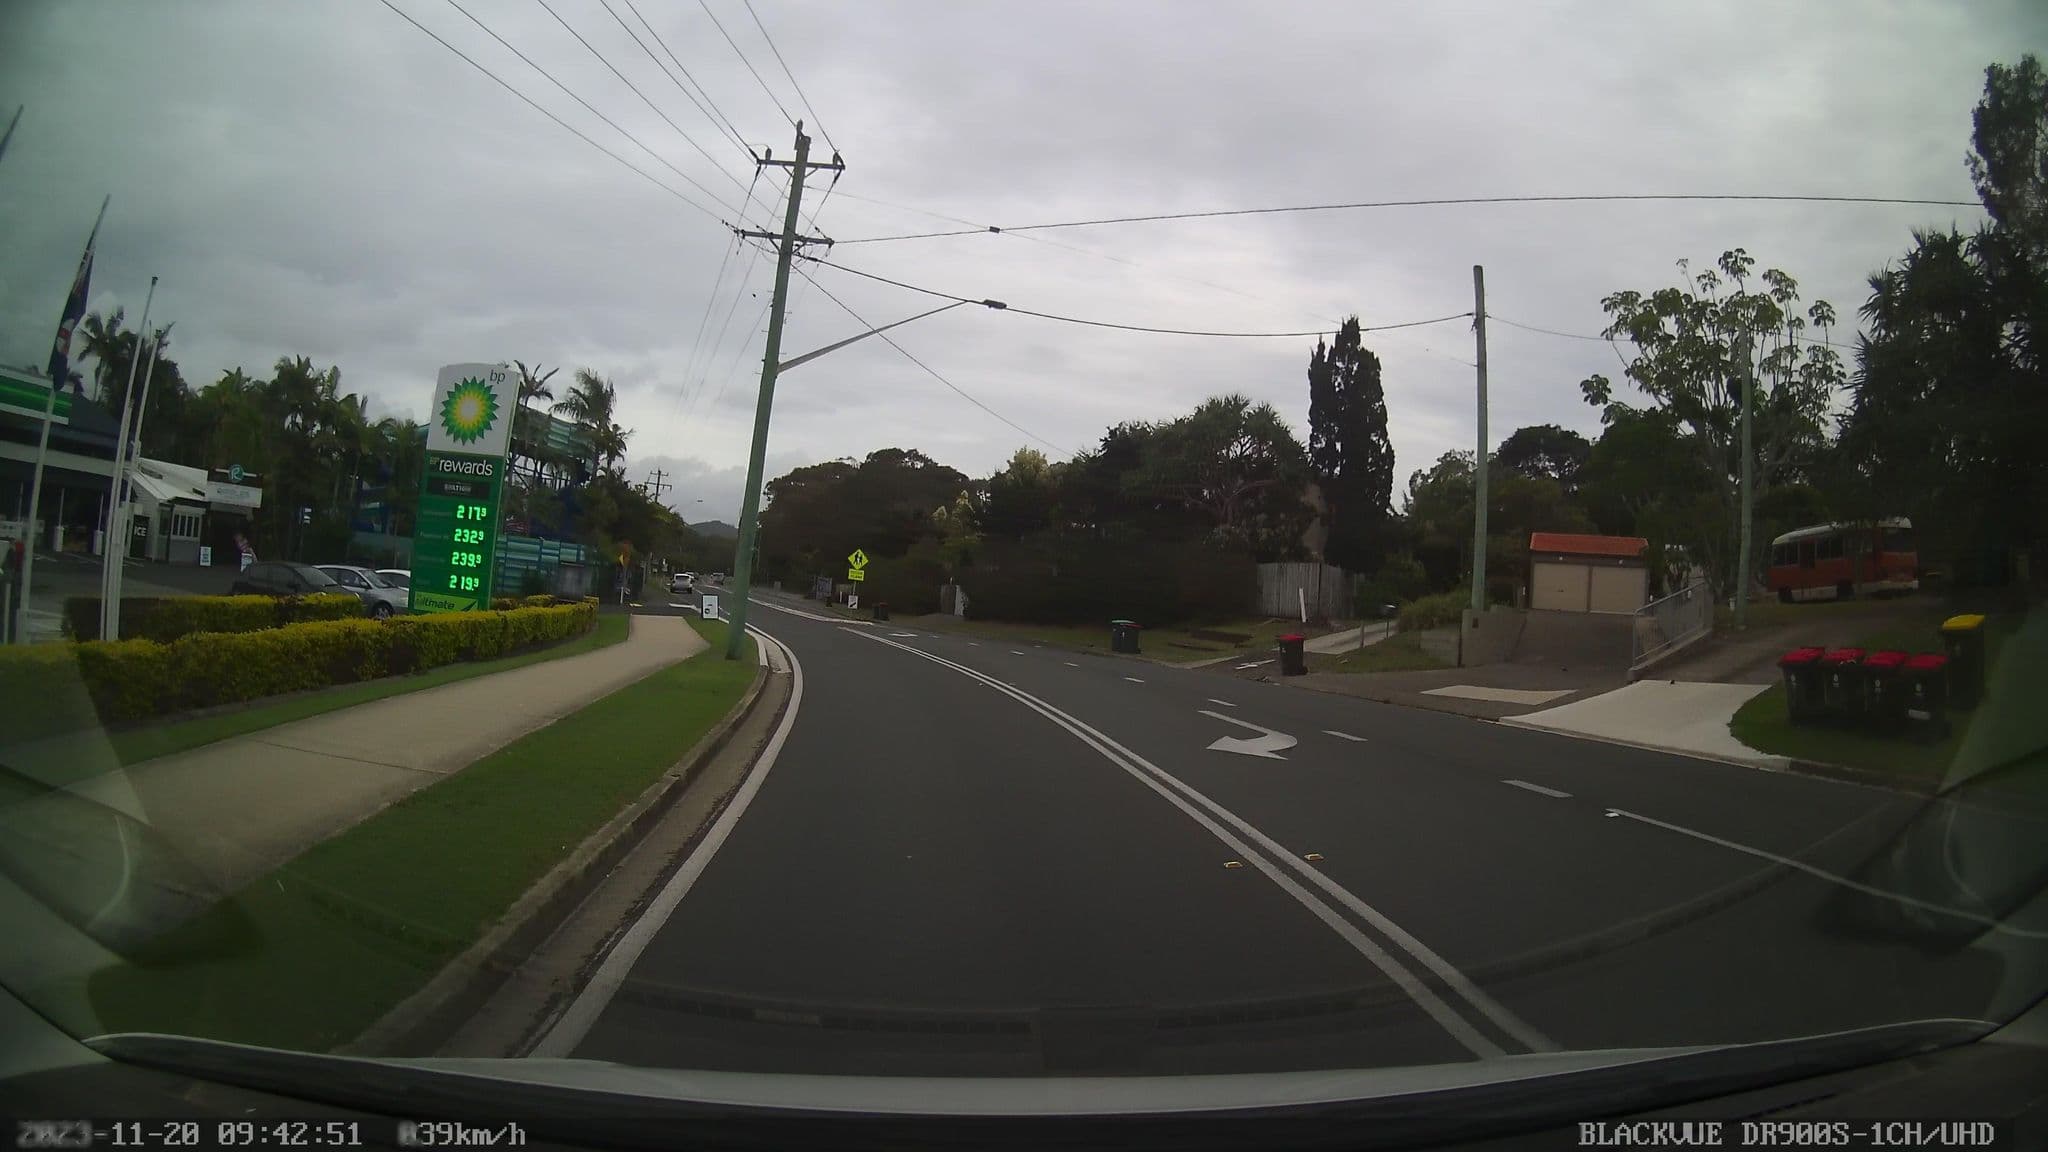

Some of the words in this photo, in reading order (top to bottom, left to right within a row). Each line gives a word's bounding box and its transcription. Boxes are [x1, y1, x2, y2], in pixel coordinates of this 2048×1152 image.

[490, 369, 506, 384] bp
[439, 459, 493, 476] rewards
[133, 526, 147, 537] ICE
